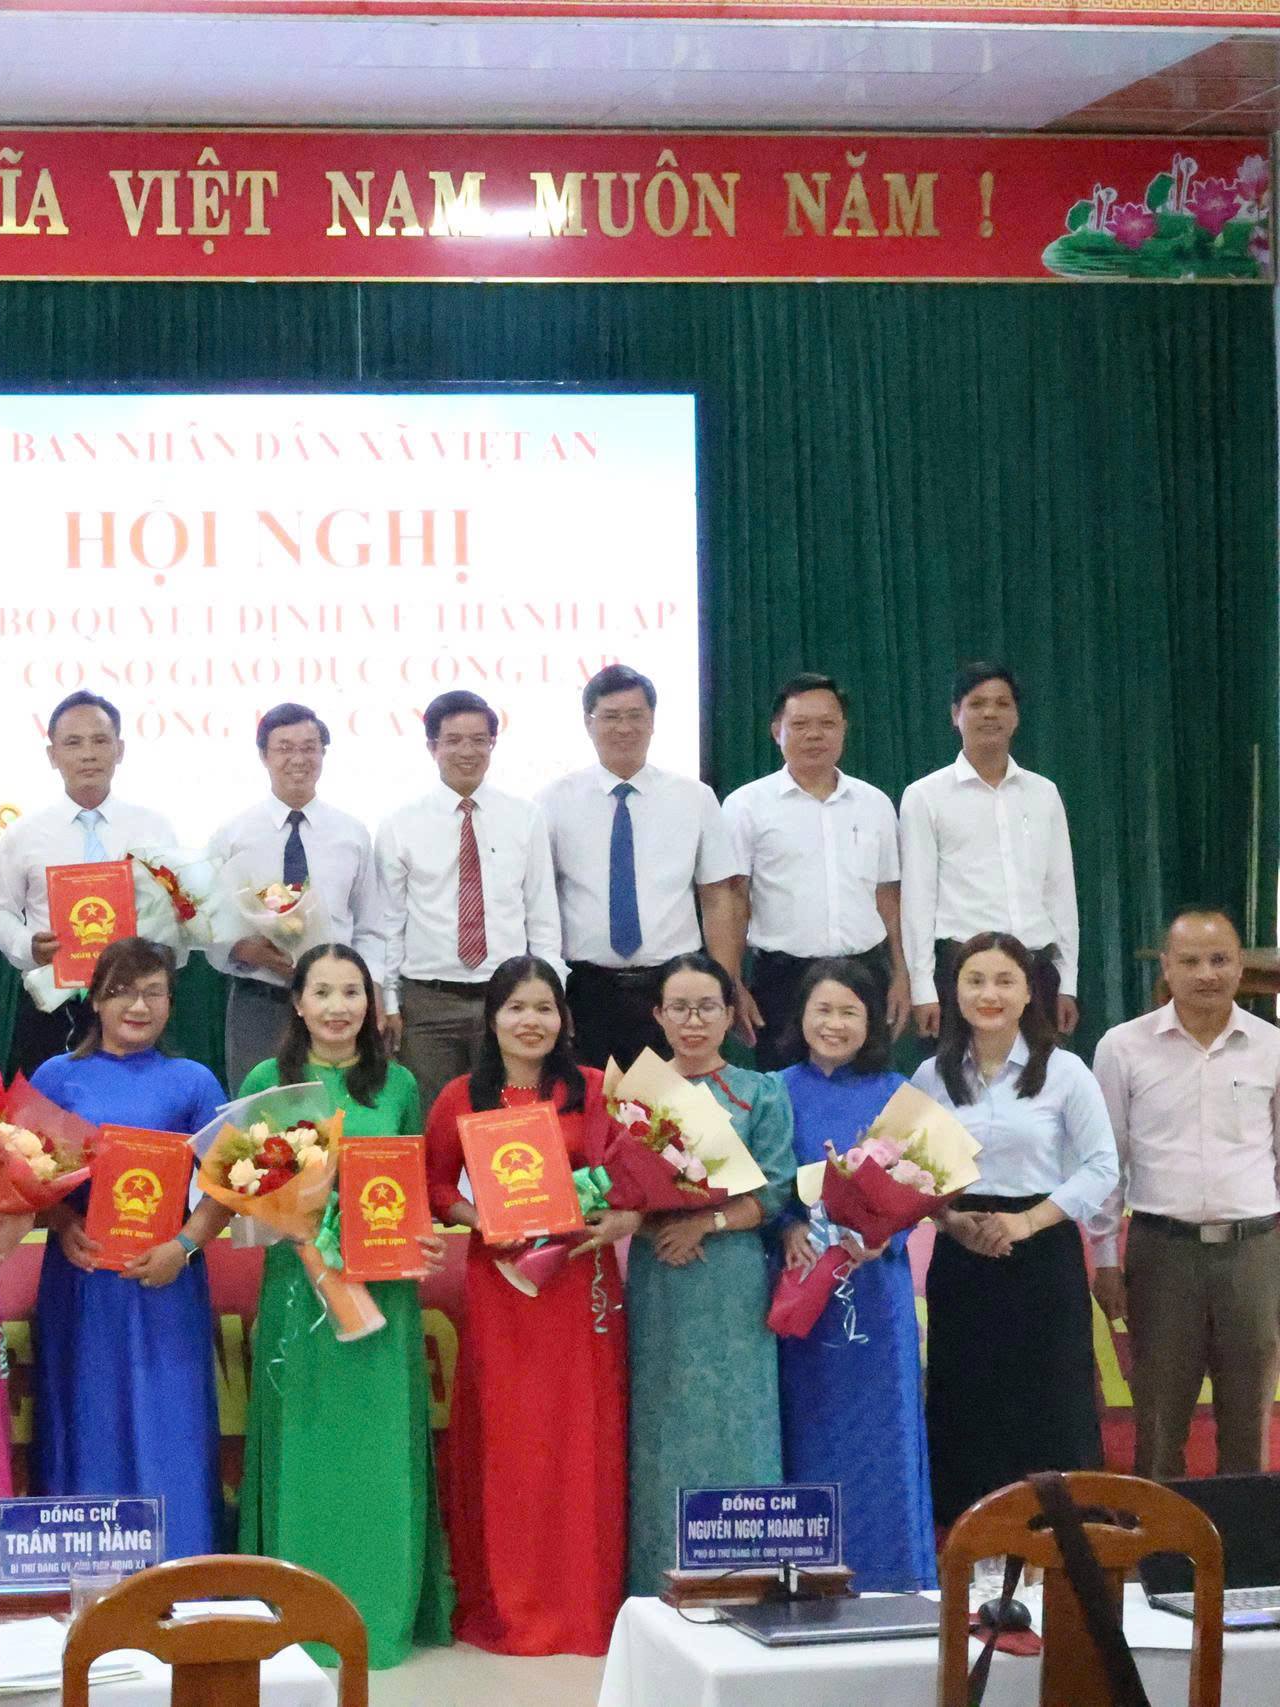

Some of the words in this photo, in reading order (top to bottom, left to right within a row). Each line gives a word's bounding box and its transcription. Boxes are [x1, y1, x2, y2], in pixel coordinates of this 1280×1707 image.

[109, 146, 279, 255] VIỆT
[325, 170, 487, 237] NAM
[529, 149, 741, 237] MUÔN
[783, 151, 940, 237] NĂM
[11, 431, 98, 464] BAN
[359, 422, 416, 463] XÃ
[543, 431, 599, 462] AN
[64, 498, 219, 588] HỘI
[255, 507, 472, 586] NGHỊ
[62, 1530, 93, 1557] THỊ
[734, 1518, 765, 1543] NGỌC
[767, 1515, 804, 1538] HOÀNG
[807, 1513, 830, 1541] VIỆT
